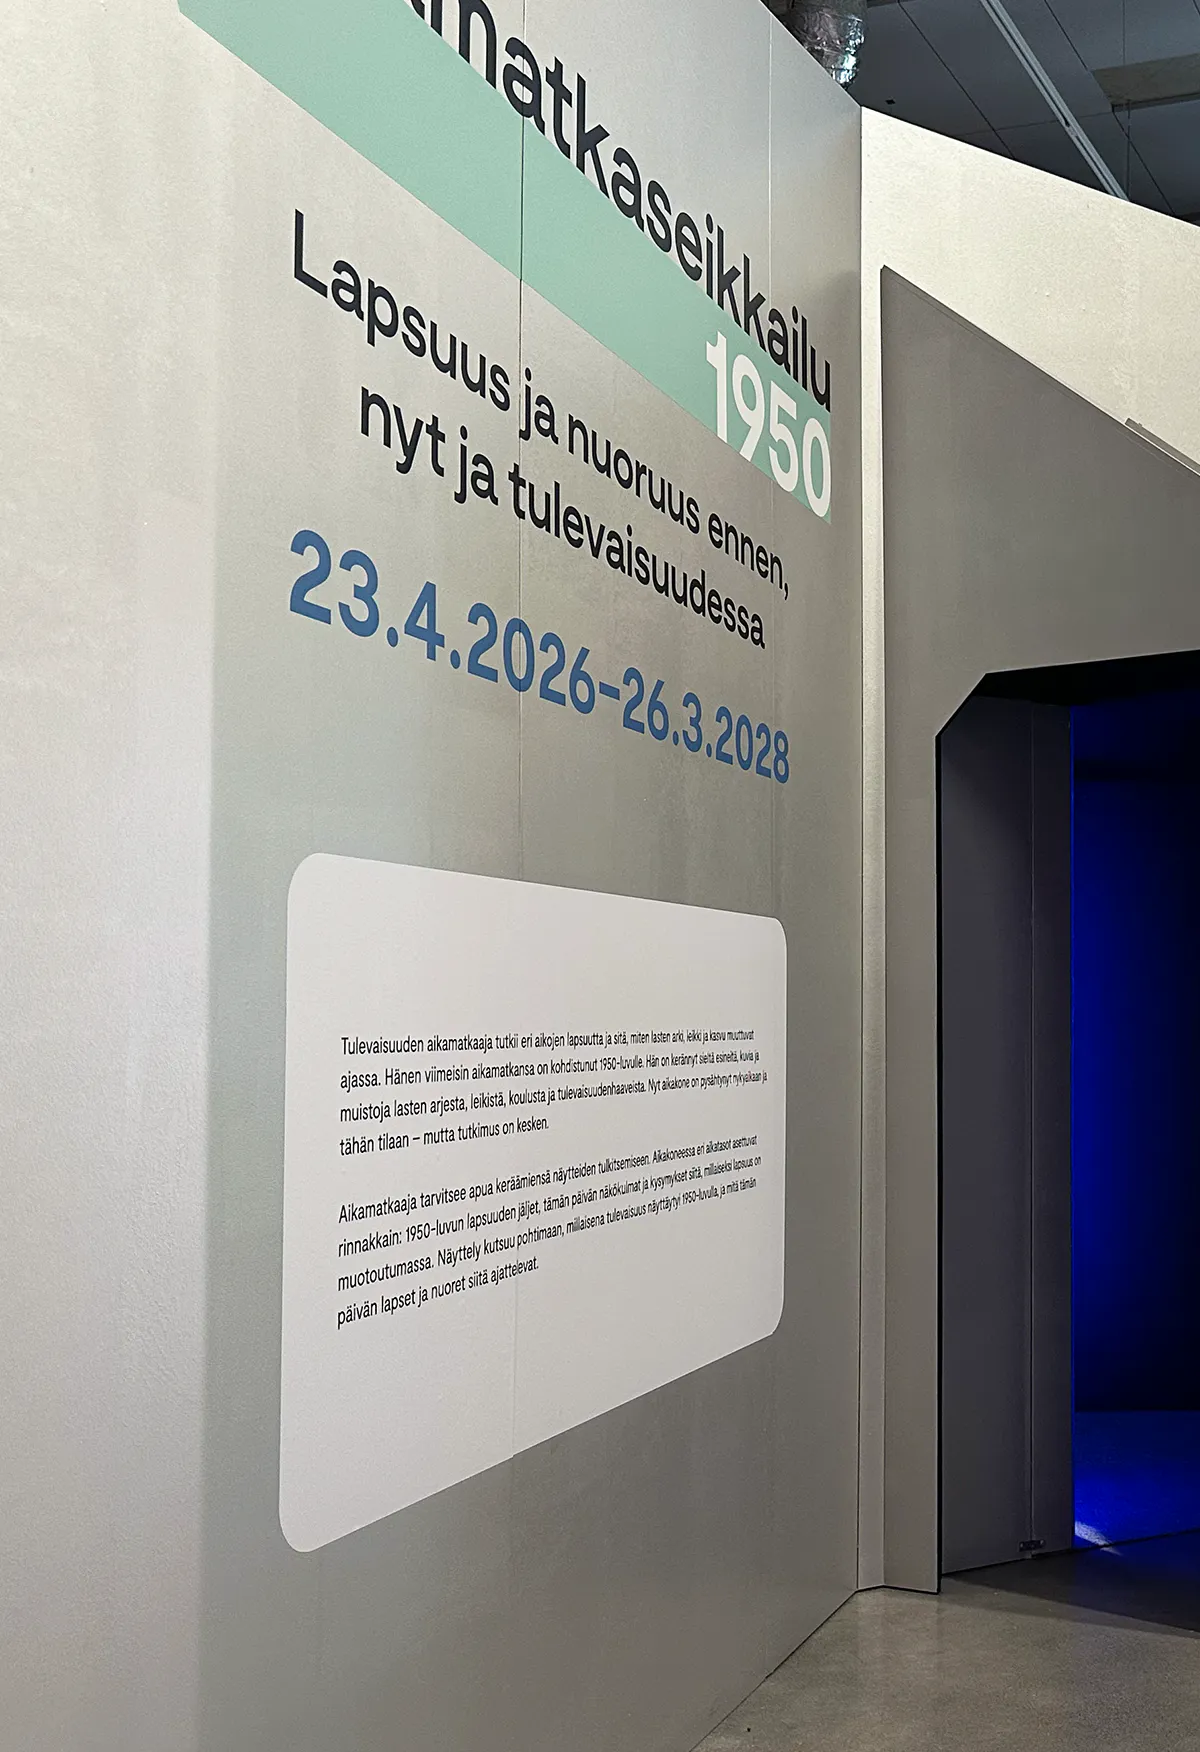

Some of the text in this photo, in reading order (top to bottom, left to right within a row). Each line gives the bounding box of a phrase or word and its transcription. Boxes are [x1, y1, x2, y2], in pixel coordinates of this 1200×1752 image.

[411, 0, 831, 413] matkaseikkailu
[293, 208, 790, 601] Lapsuus ja nuoruus ennen,
[706, 331, 832, 518] 1950
[360, 385, 766, 650] nyt ja tulevaisuudessa
[341, 1036, 424, 1055] Tulevaisuuden
[427, 1034, 493, 1054] aikamatkaaja
[495, 1033, 519, 1049] tutkii
[521, 1033, 533, 1048] eri
[535, 1032, 565, 1050] aikojen
[567, 1032, 604, 1049] lapsuutta
[604, 1033, 612, 1048] ja
[614, 1032, 628, 1046] sitä,
[630, 1031, 649, 1044] miten
[651, 1030, 670, 1043] lasten
[703, 1029, 708, 1044] ja
[341, 1071, 381, 1093] ajassa.
[385, 1067, 421, 1085] Hänen
[424, 1065, 469, 1083] viimeisin
[472, 1062, 535, 1079] aikamatkansa
[537, 1063, 549, 1075] on
[550, 1057, 598, 1074] kohdistunut
[599, 1054, 644, 1072] 1950-luvulle.
[646, 1053, 660, 1068] Hän
[661, 1055, 670, 1066] on
[671, 1053, 698, 1067] kerännyt
[754, 1049, 760, 1064] ja
[340, 1102, 390, 1123] muistoja
[394, 1100, 427, 1117] lasten
[430, 1096, 468, 1116] arjesta,
[470, 1092, 506, 1110] leikistä,
[509, 1088, 546, 1106] koulusta
[547, 1088, 555, 1106] ja
[558, 1079, 646, 1100] tulevaisuudenhaaveista.
[649, 1078, 661, 1094] Nyt
[662, 1076, 690, 1090] aikakone
[691, 1078, 699, 1087] on
[762, 1070, 768, 1084] ja
[340, 1137, 374, 1156] tähän
[378, 1133, 409, 1151] tilaan
[423, 1127, 455, 1145] mutta
[458, 1122, 500, 1141] tutkimus
[502, 1122, 515, 1135] on
[517, 1116, 549, 1134] kesken.
[338, 1231, 402, 1257] rinnakkain:
[405, 1218, 464, 1242] 1950-luvun
[467, 1206, 516, 1232] lapsuuden
[517, 1199, 541, 1221] jäljet,
[543, 1196, 569, 1213] tämän
[571, 1189, 597, 1209] päivän
[599, 1179, 641, 1200] näkökulmat
[642, 1177, 649, 1194] ja
[650, 1169, 687, 1192] kysymykset
[754, 1156, 761, 1165] on
[339, 1194, 417, 1223] Aikamatkaaja
[420, 1187, 466, 1208] tarvitsee
[469, 1184, 494, 1202] apua
[495, 1170, 551, 1194] keräämiensä
[553, 1163, 596, 1185] näytteiden
[598, 1154, 650, 1174] tulkitsemiseen.
[652, 1147, 696, 1164] Aikakoneessa
[696, 1142, 705, 1156] eri
[338, 1257, 434, 1291] muotoutumassa.
[437, 1244, 481, 1267] Näyttely
[483, 1235, 515, 1255] kutsuu
[517, 1223, 565, 1250] pohtimaan,
[566, 1214, 605, 1235] millaisena
[606, 1204, 646, 1224] tulevaisuus
[720, 1183, 725, 1199] ja
[337, 1256, 539, 1330] päivän lapset ja nuoret siitä ajattelevat.
